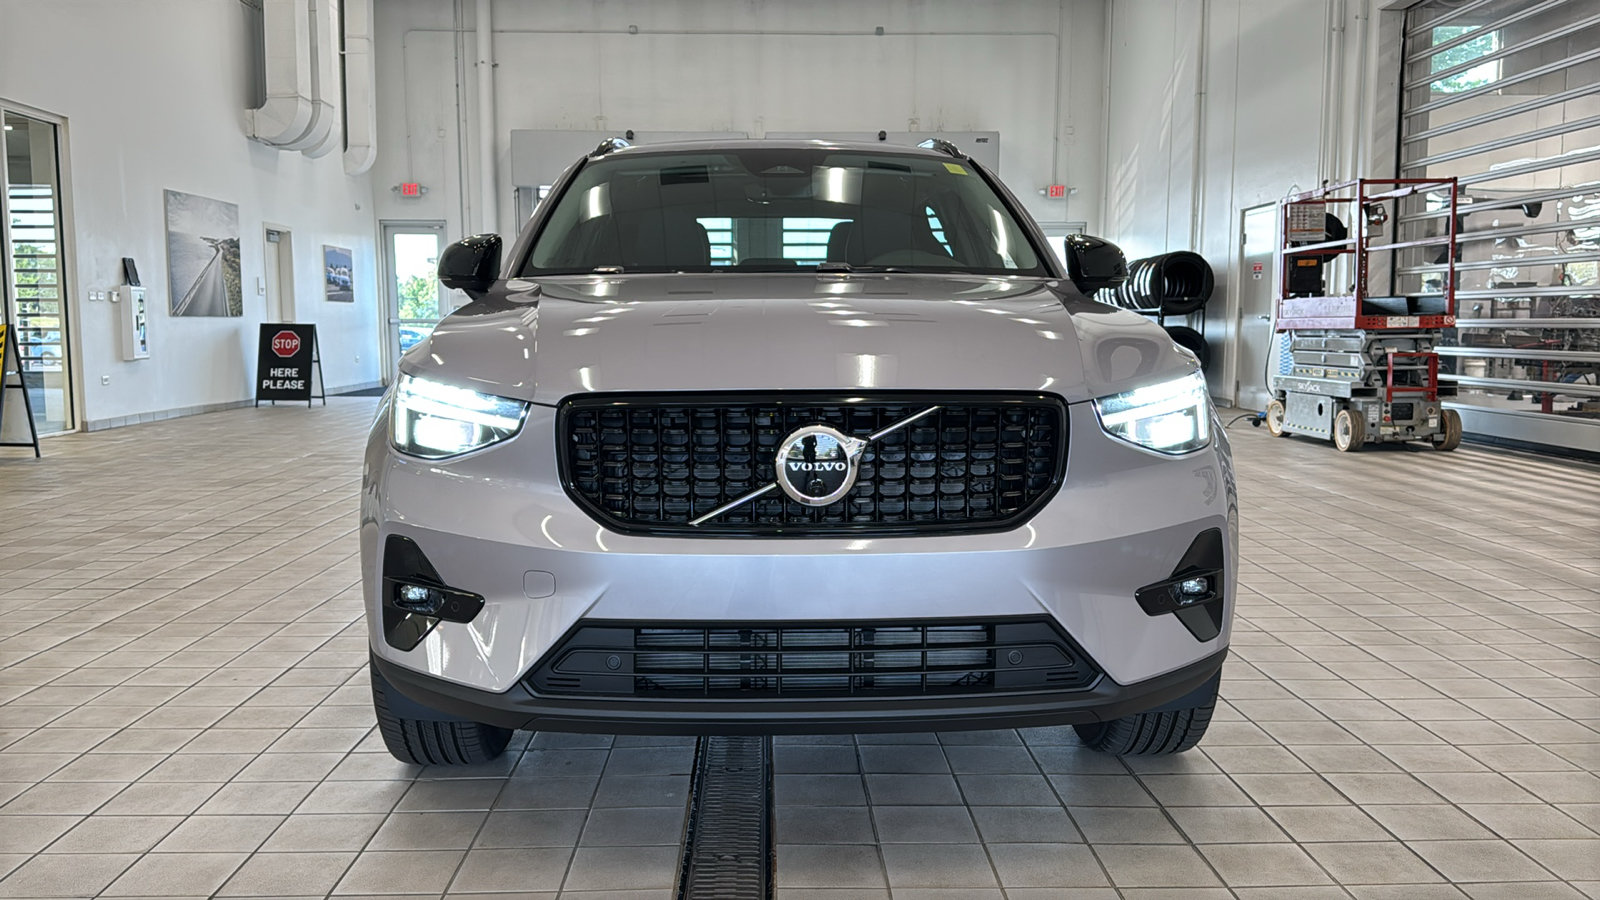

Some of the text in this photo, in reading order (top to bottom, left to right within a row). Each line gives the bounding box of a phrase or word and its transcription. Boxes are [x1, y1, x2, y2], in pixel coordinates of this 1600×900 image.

[402, 183, 417, 195] EXIT
[1050, 185, 1065, 197] EXIT
[274, 338, 299, 349] STOP
[270, 367, 299, 378] HERE
[262, 379, 305, 390] PLEASE
[788, 461, 847, 471] VOLVO
